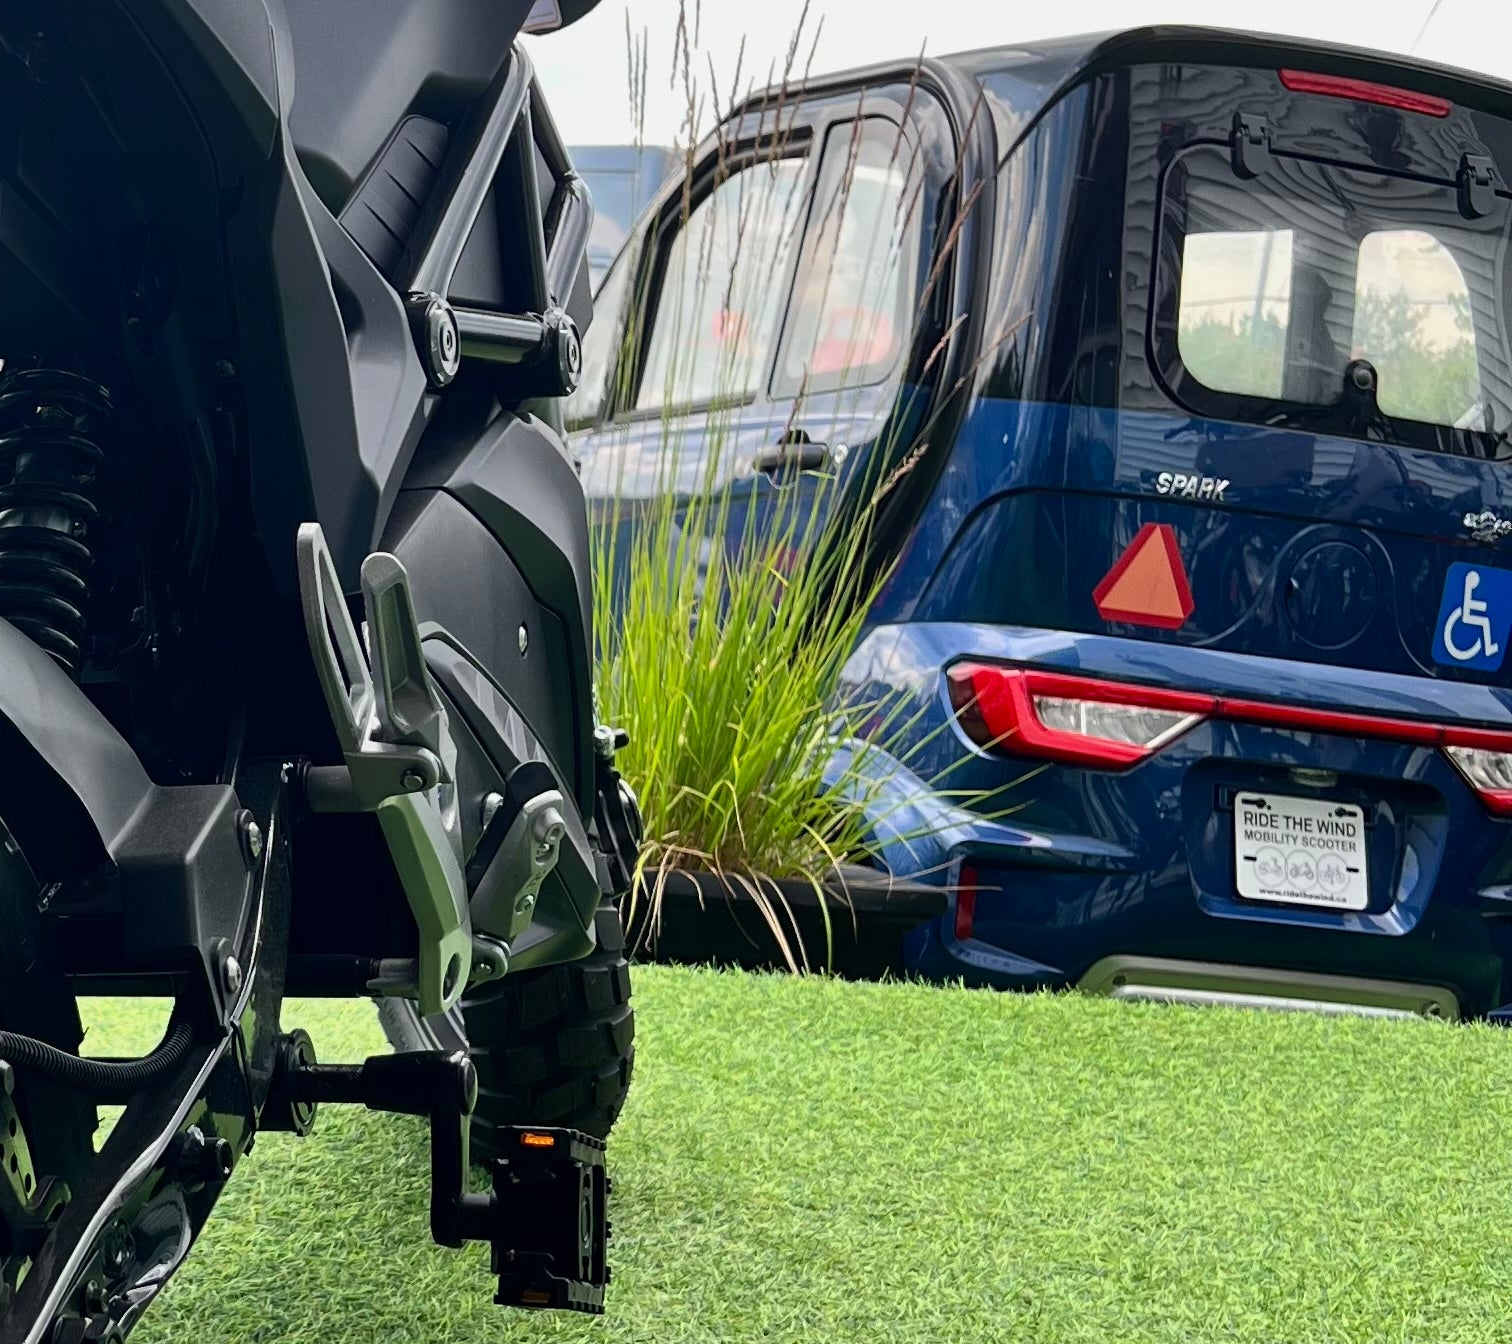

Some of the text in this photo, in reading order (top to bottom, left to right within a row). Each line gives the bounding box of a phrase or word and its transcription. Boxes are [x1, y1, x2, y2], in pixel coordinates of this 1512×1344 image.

[1156, 471, 1230, 502] SPARK
[1243, 810, 1356, 838] RIDE THE WIND
[1244, 829, 1357, 853] MOBILITY SCOOTER
